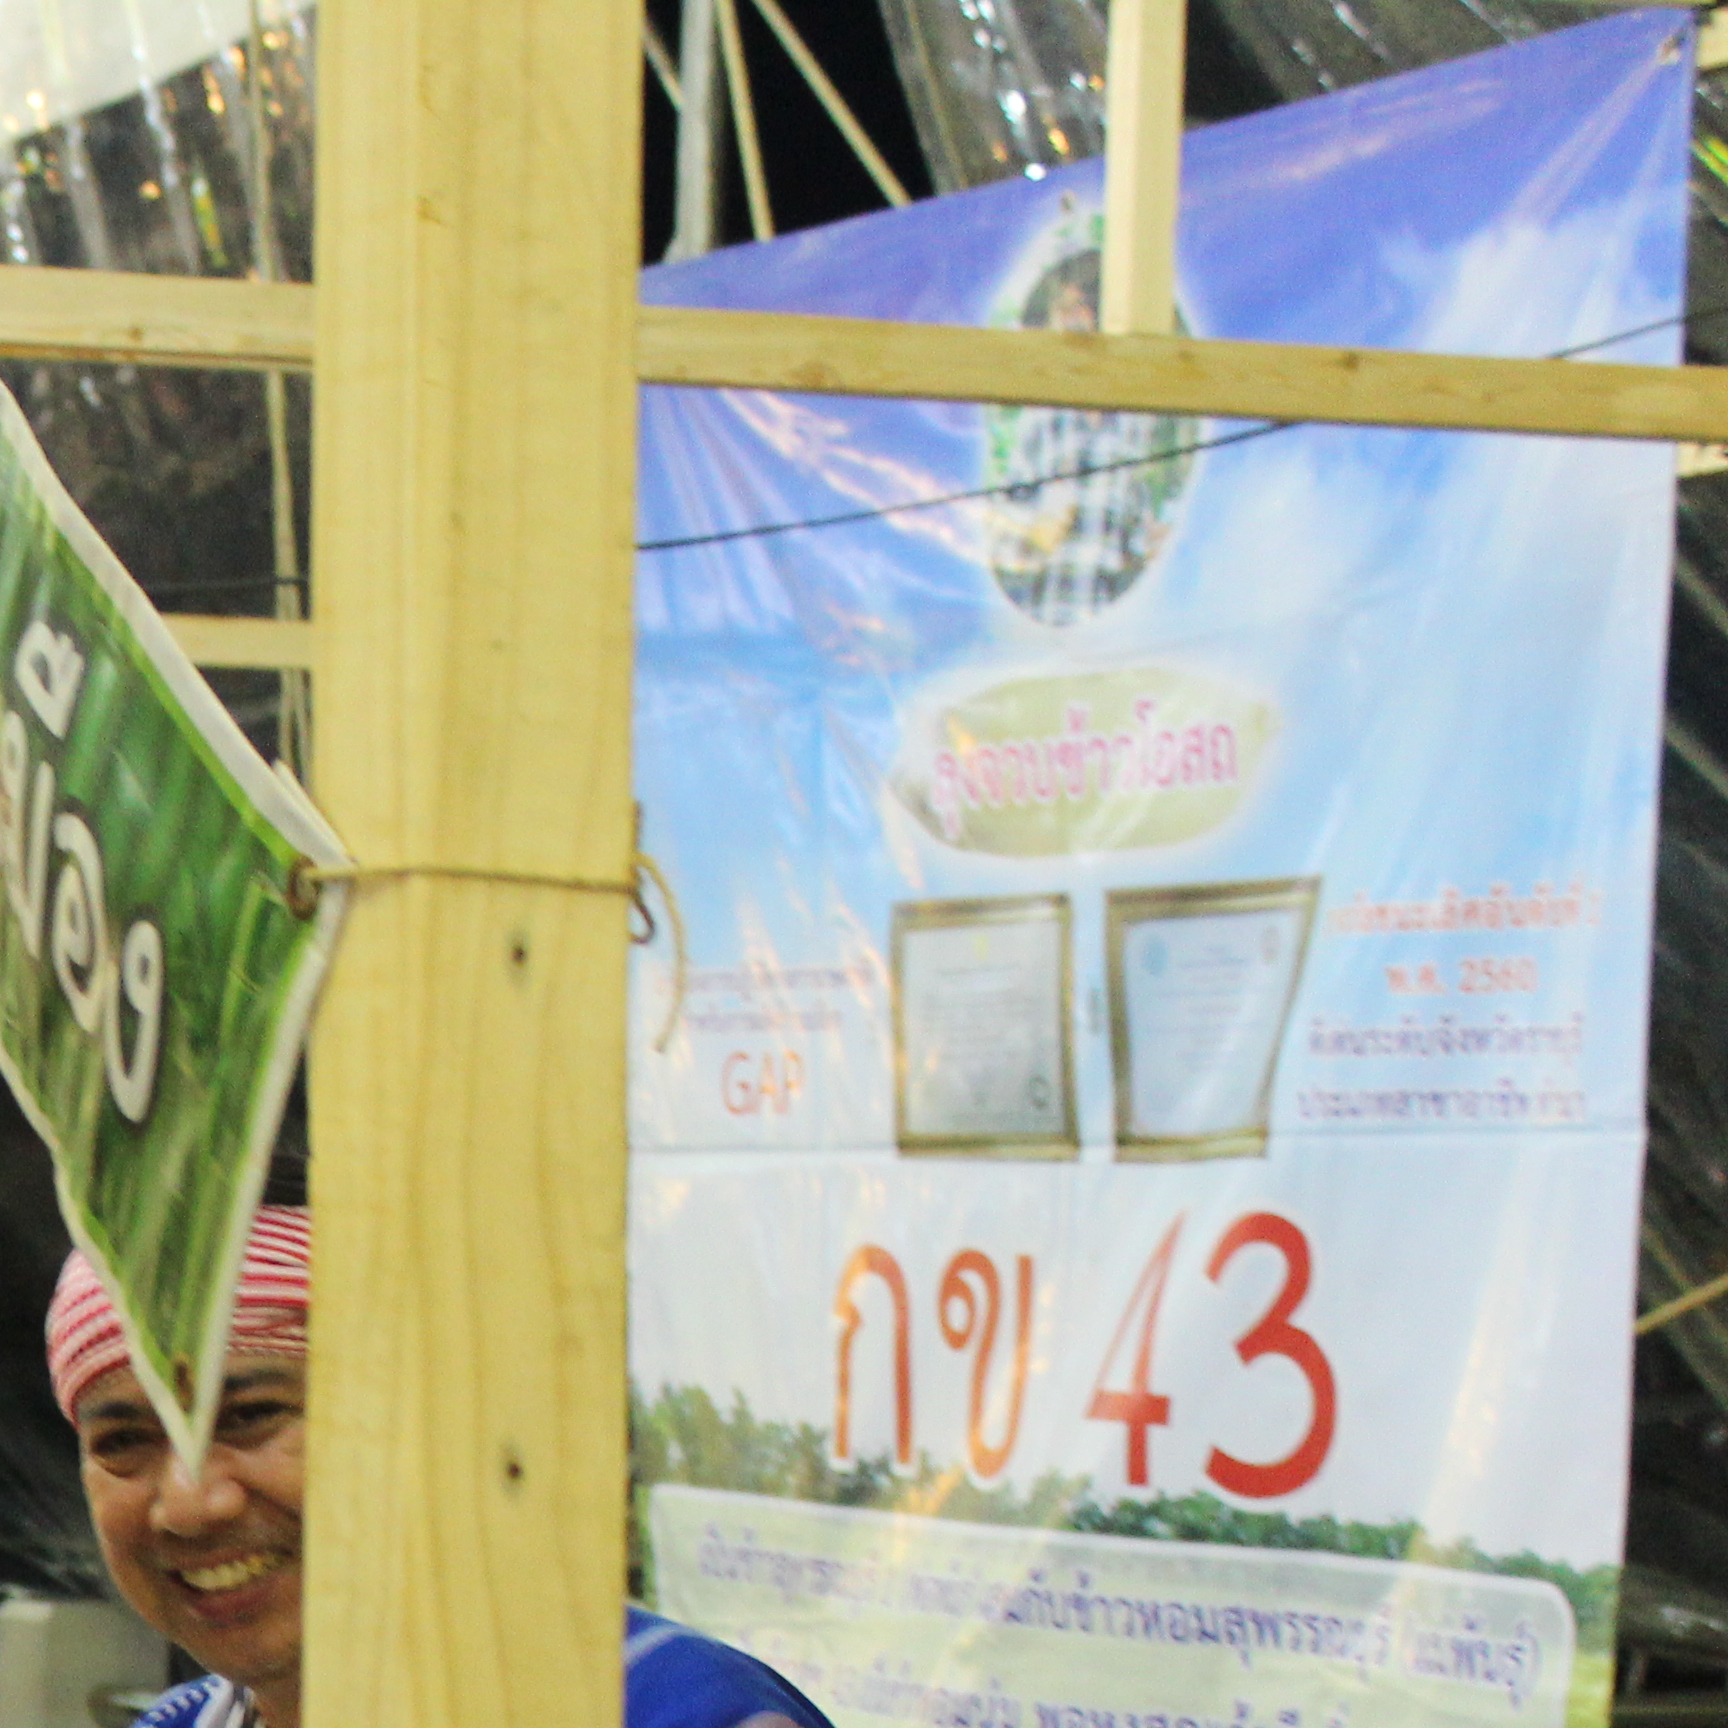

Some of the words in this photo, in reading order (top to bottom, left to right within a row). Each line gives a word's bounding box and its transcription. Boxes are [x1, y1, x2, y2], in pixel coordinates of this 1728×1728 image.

[720, 1050, 805, 1115] GAP
[833, 1240, 1035, 1480] กข
[1085, 1208, 1338, 1500] 43
